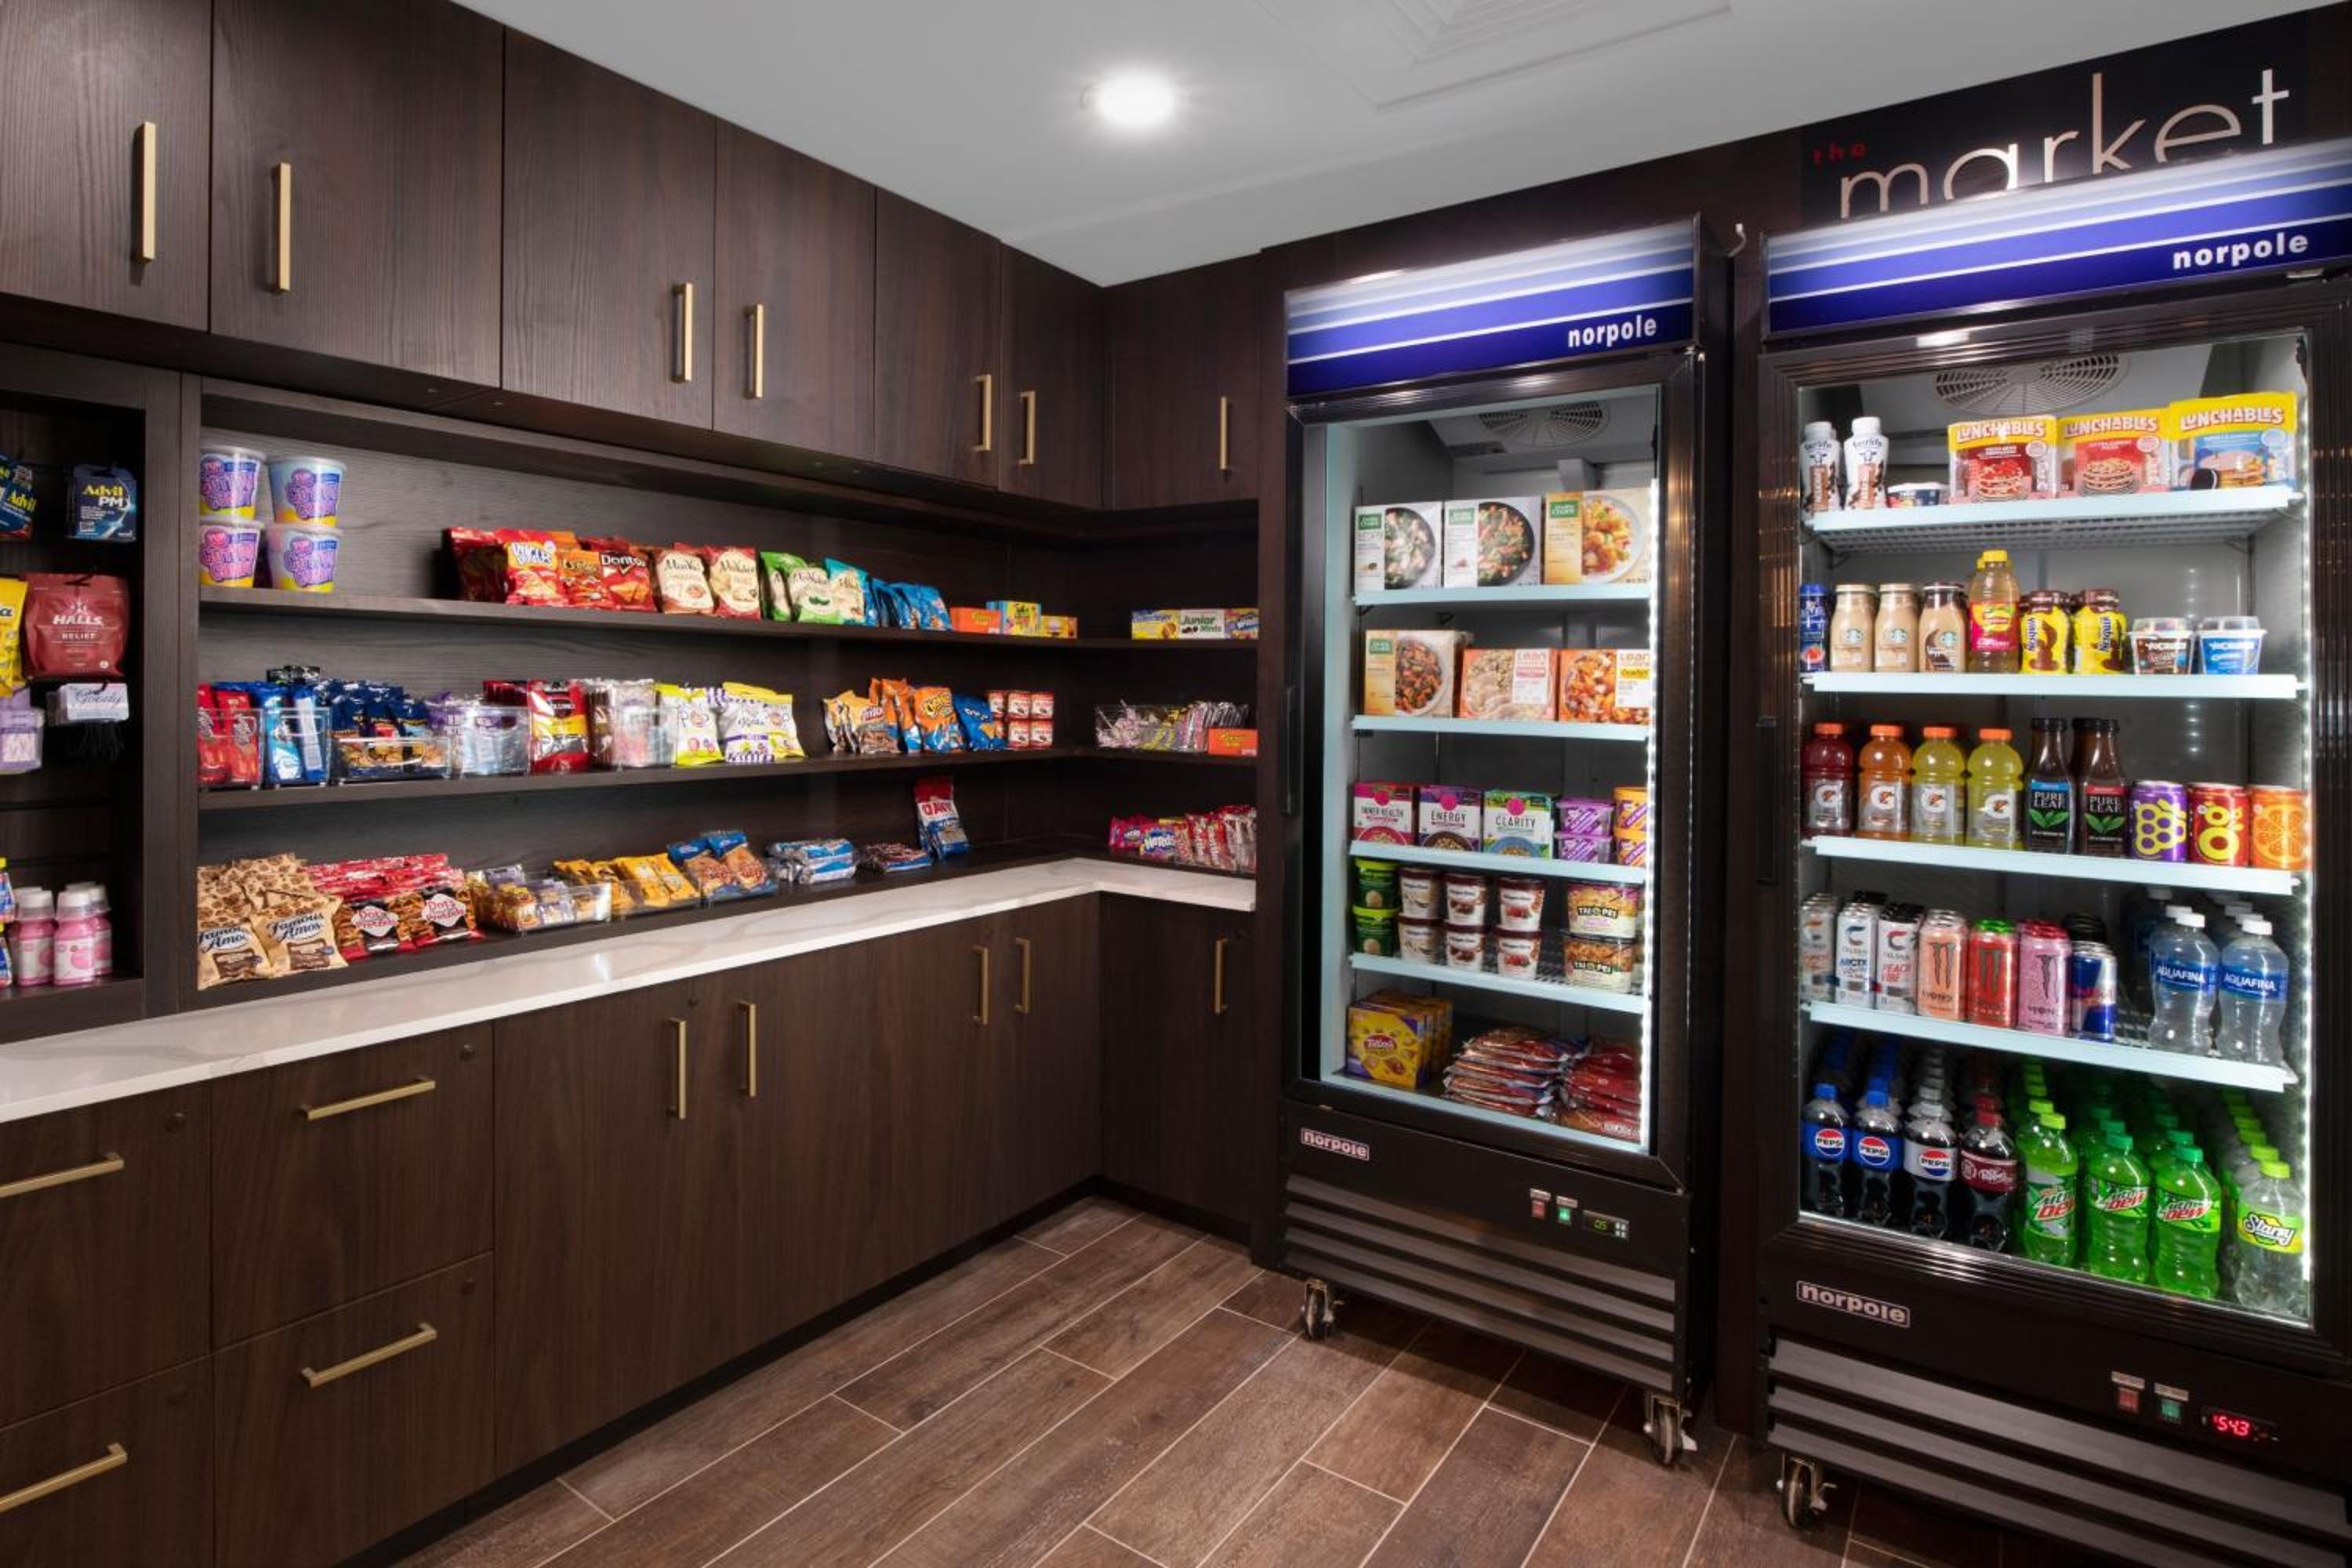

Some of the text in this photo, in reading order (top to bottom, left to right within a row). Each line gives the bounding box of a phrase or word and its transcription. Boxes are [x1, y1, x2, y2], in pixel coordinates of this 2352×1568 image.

[1840, 68, 2290, 220] market
[1813, 141, 1867, 165] the
[2172, 232, 2310, 270] norpole
[1568, 314, 1657, 347] norpole
[2180, 406, 2285, 431] LUNCHABLES
[1955, 420, 2046, 445] LUNCHABLES
[2064, 416, 2158, 439] LUNCHABLES
[82, 485, 123, 496] Advil
[99, 496, 124, 507] PM
[53, 614, 103, 626] HALLS
[1181, 615, 1216, 626] Junior
[2034, 791, 2065, 800] PURE
[2089, 795, 2121, 805] PURE
[2034, 799, 2066, 809] LEAF
[2089, 804, 2121, 813] LEAF
[1431, 810, 1467, 822] ENERGY
[1496, 815, 1536, 828] CLARITY
[267, 912, 325, 934] Famous
[2157, 964, 2205, 984] AQUAFINA
[2223, 971, 2277, 992] AQUAFINA
[1304, 1130, 1367, 1159] norpole
[1817, 1138, 1844, 1146] PEPSI
[1860, 1145, 1889, 1156] PEPSI
[1920, 1158, 1950, 1168] PEPSI
[1801, 1283, 1907, 1325] norpole
